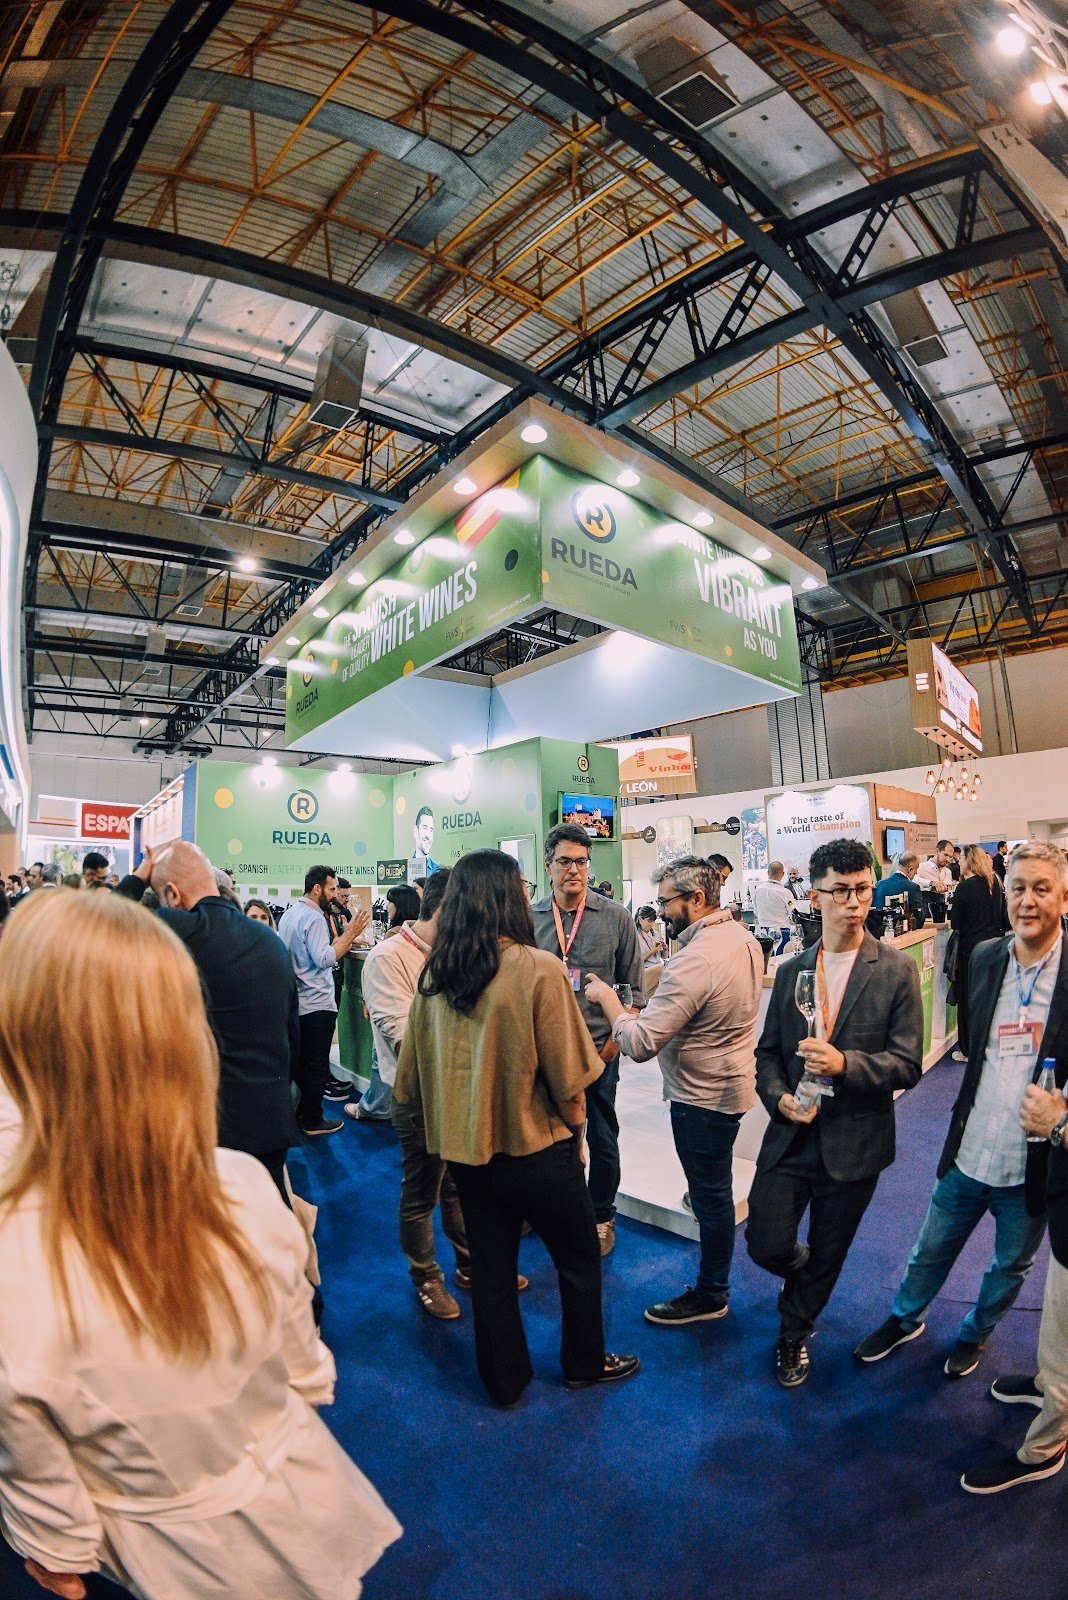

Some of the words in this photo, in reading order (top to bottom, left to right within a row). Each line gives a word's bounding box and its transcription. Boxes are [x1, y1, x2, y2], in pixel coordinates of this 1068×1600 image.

[551, 537, 638, 590] RUEDA
[693, 557, 782, 639] VIBRANT
[370, 601, 416, 664] WHITE
[418, 560, 478, 632] WINES
[743, 626, 758, 652] AS
[757, 633, 778, 661] YOU
[349, 652, 370, 678] QUALITY
[296, 687, 319, 716] RUEDA
[580, 759, 586, 769] R
[572, 774, 596, 784] RUEDA
[626, 780, 658, 794] LEÓN
[296, 797, 310, 815] R
[84, 813, 130, 834] ESPA
[442, 810, 482, 830] RUEDA
[783, 823, 811, 835] World
[812, 819, 861, 832] Champion
[790, 815, 808, 825] The
[809, 814, 832, 824] taste
[834, 811, 845, 821] of
[272, 830, 332, 846] RUEDA
[238, 863, 268, 874] SPANISH
[333, 865, 353, 875] WHITE
[355, 866, 375, 875] WINES
